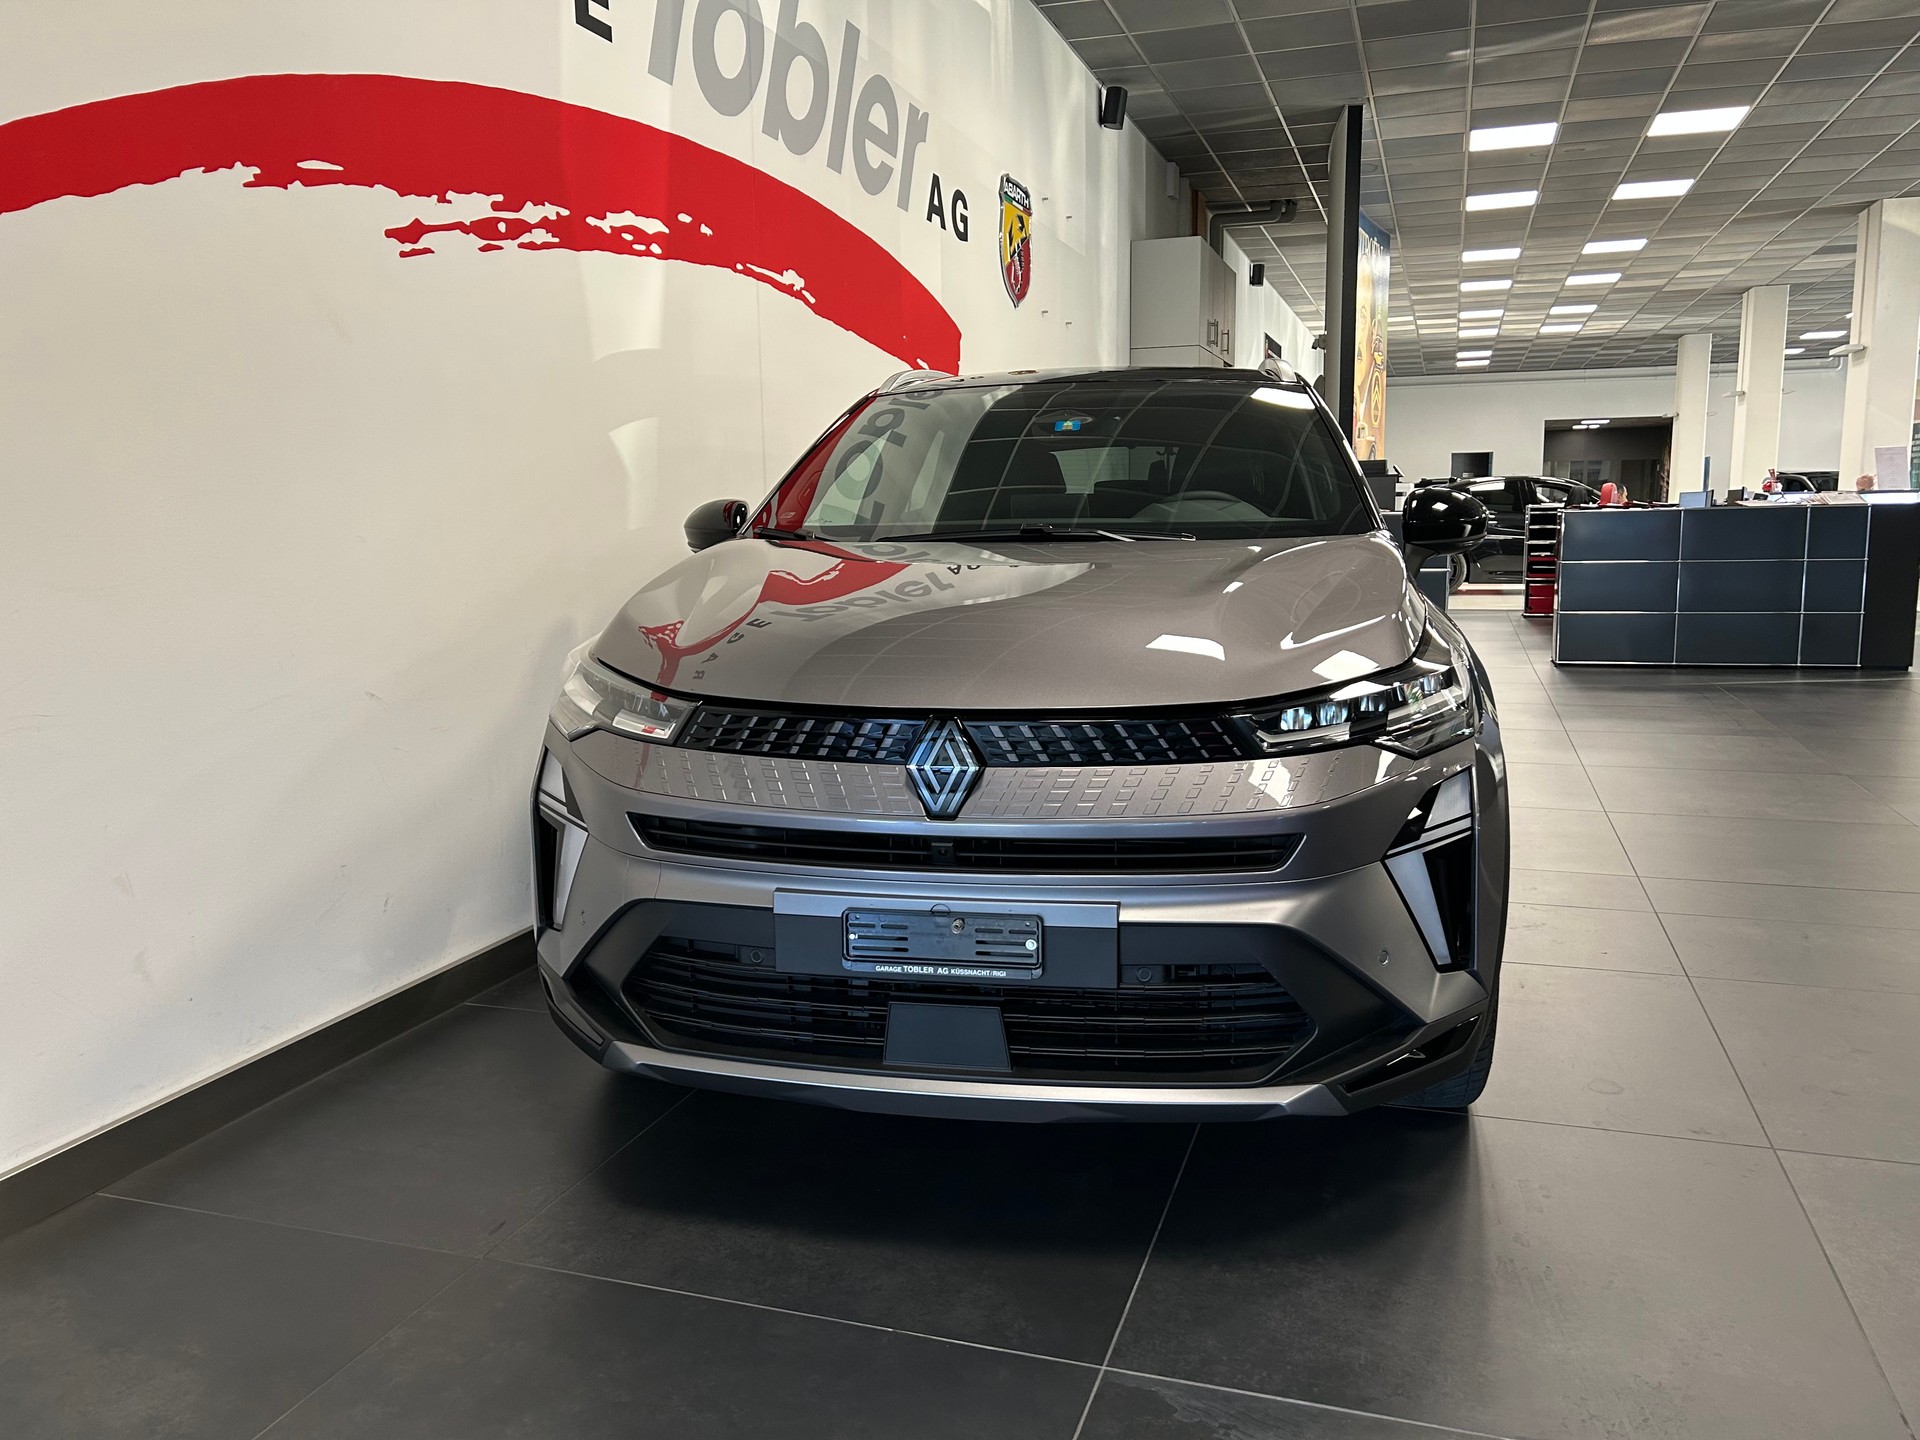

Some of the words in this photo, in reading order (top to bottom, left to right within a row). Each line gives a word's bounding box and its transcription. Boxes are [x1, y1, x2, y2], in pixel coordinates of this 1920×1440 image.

[927, 173, 968, 242] AG
[1003, 180, 1029, 208] ABARTH
[875, 965, 902, 973] GARAGE
[903, 965, 934, 974] TOBLER
[937, 967, 949, 975] AG
